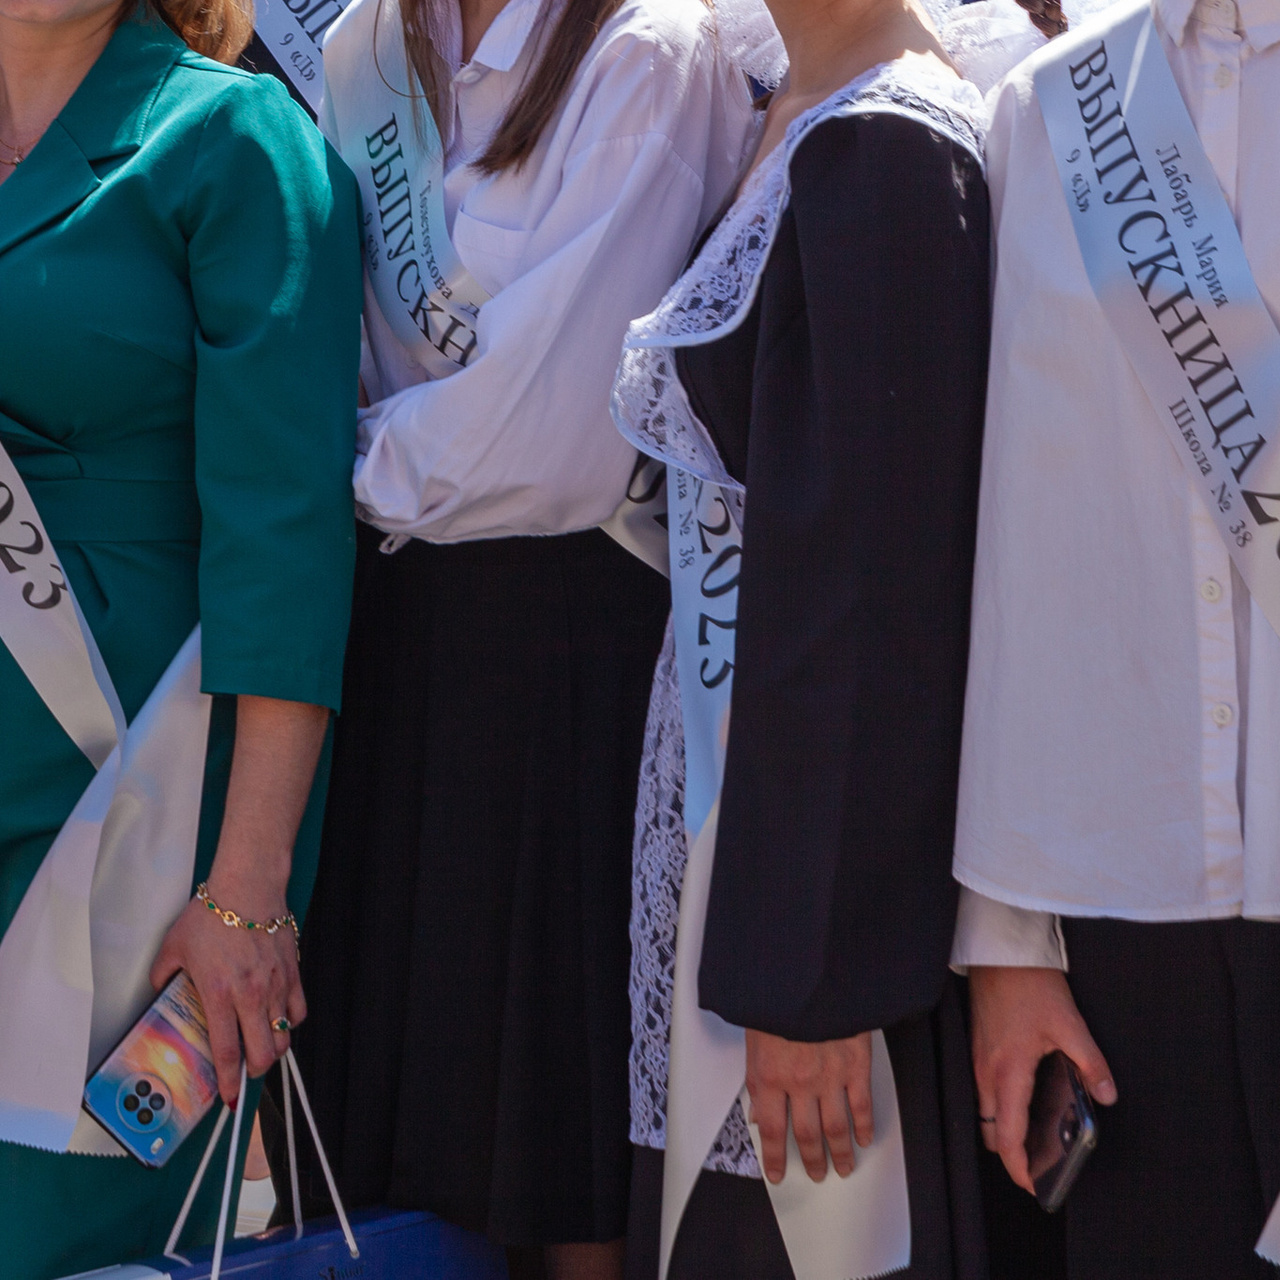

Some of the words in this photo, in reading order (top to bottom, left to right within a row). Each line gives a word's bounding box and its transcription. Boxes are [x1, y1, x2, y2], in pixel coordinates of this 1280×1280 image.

[279, 32, 294, 46] 9
[1065, 148, 1081, 163] 9
[1068, 39, 1267, 484] ВЫПУСКНИЦА
[1156, 142, 1200, 230] Лабарь
[1191, 232, 1229, 308] Мария
[1167, 397, 1214, 477] Школа
[1210, 480, 1233, 514] №
[1229, 519, 1253, 548] 38
[678, 545, 696, 570] 38
